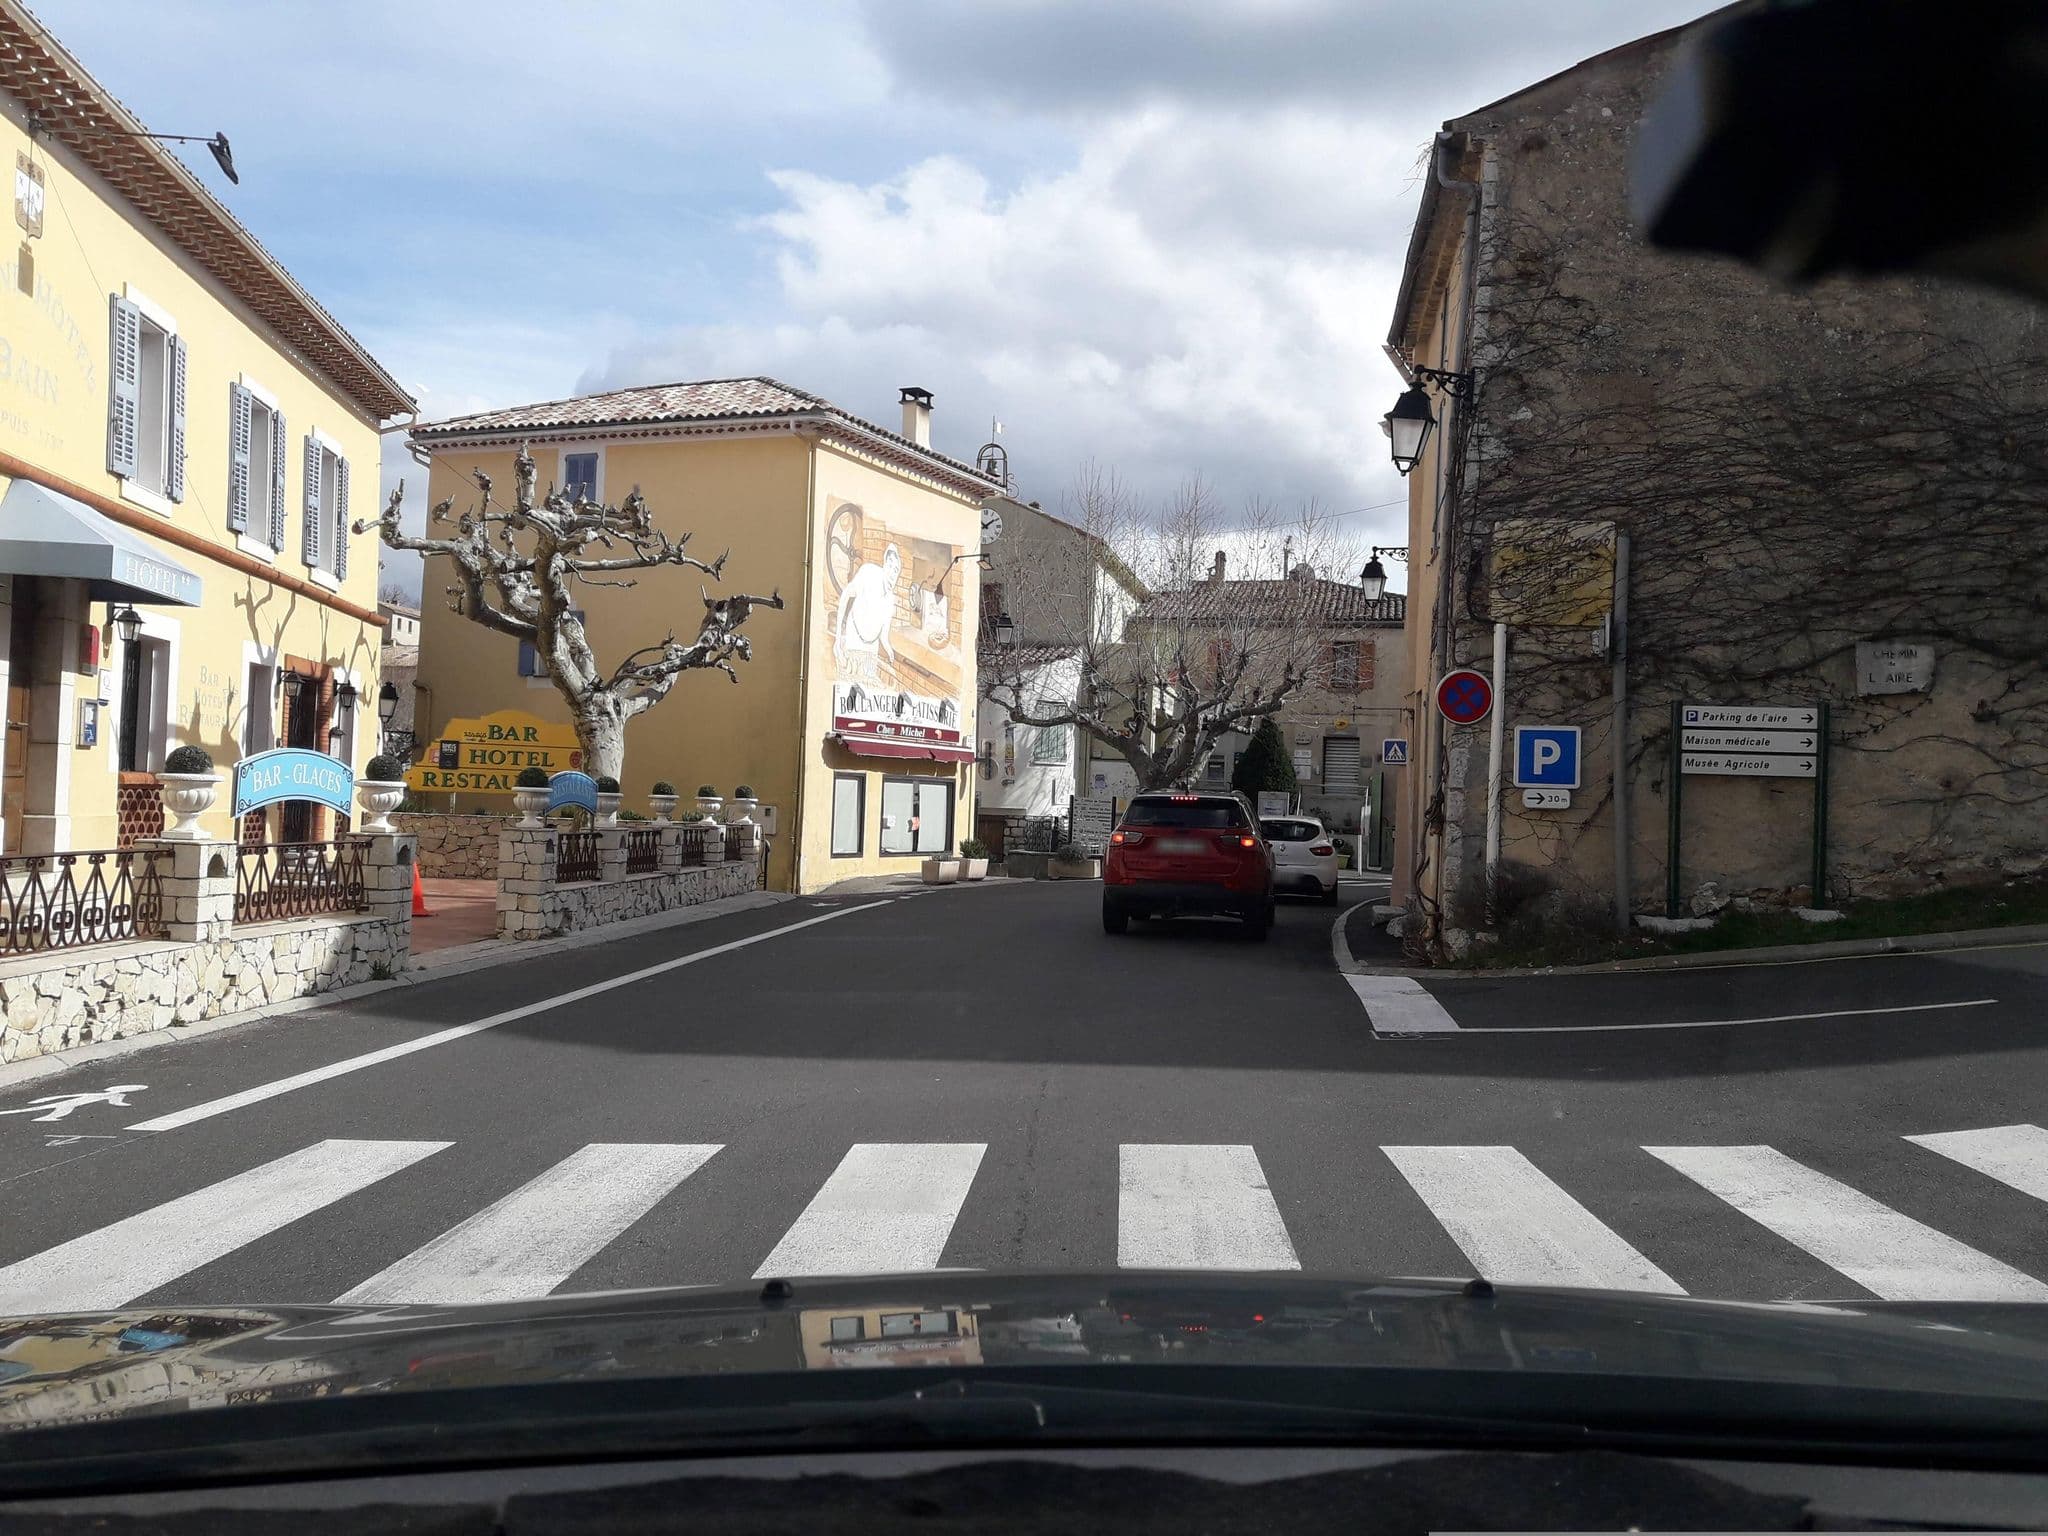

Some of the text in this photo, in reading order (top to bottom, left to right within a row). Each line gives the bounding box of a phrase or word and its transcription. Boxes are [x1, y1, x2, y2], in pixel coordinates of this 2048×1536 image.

[126, 558, 180, 598] HÔTEL
[1702, 712, 1742, 724] Parking
[1745, 713, 1758, 722] de
[1762, 713, 1788, 723] l'aire
[488, 724, 539, 742] BAR
[900, 726, 926, 737] Michel
[1685, 735, 1771, 747] Maison médicale
[469, 748, 555, 767] HOTEL
[1533, 738, 1561, 775] P
[1685, 758, 1770, 770] Musée Agricole
[253, 764, 281, 793] BAR
[293, 763, 342, 794] GLACES
